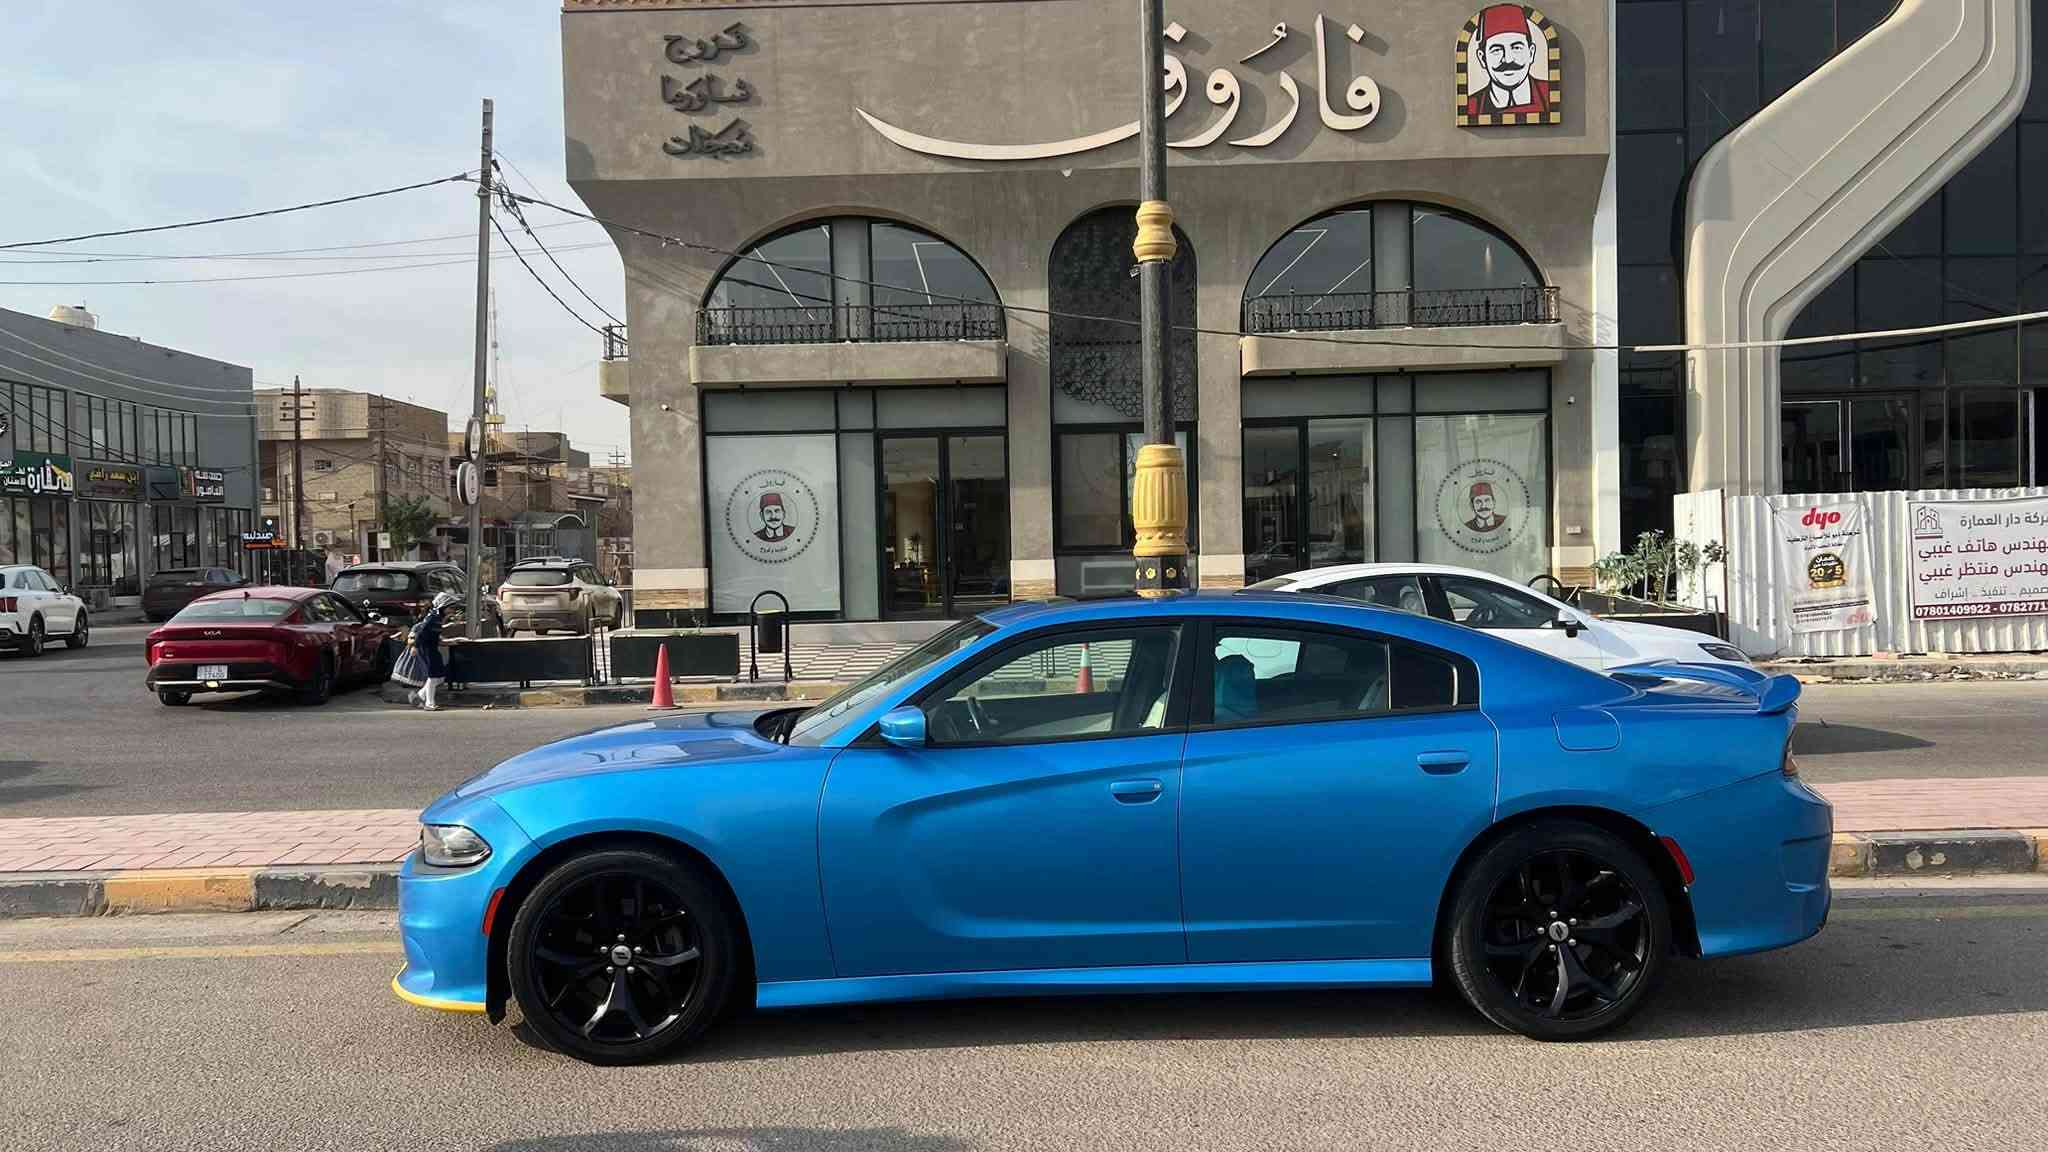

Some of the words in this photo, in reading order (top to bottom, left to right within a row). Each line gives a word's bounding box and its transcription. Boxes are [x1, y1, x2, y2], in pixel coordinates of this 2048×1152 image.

[1802, 507, 1841, 530] dyo
[1960, 513, 2002, 530] العمارة
[2005, 513, 2021, 528] دار
[1958, 537, 1998, 553] هاتف
[2002, 536, 2048, 555] هندس
[1957, 561, 1999, 581] منتظر
[2004, 559, 2048, 578] هندس
[2019, 585, 2048, 598] صميم
